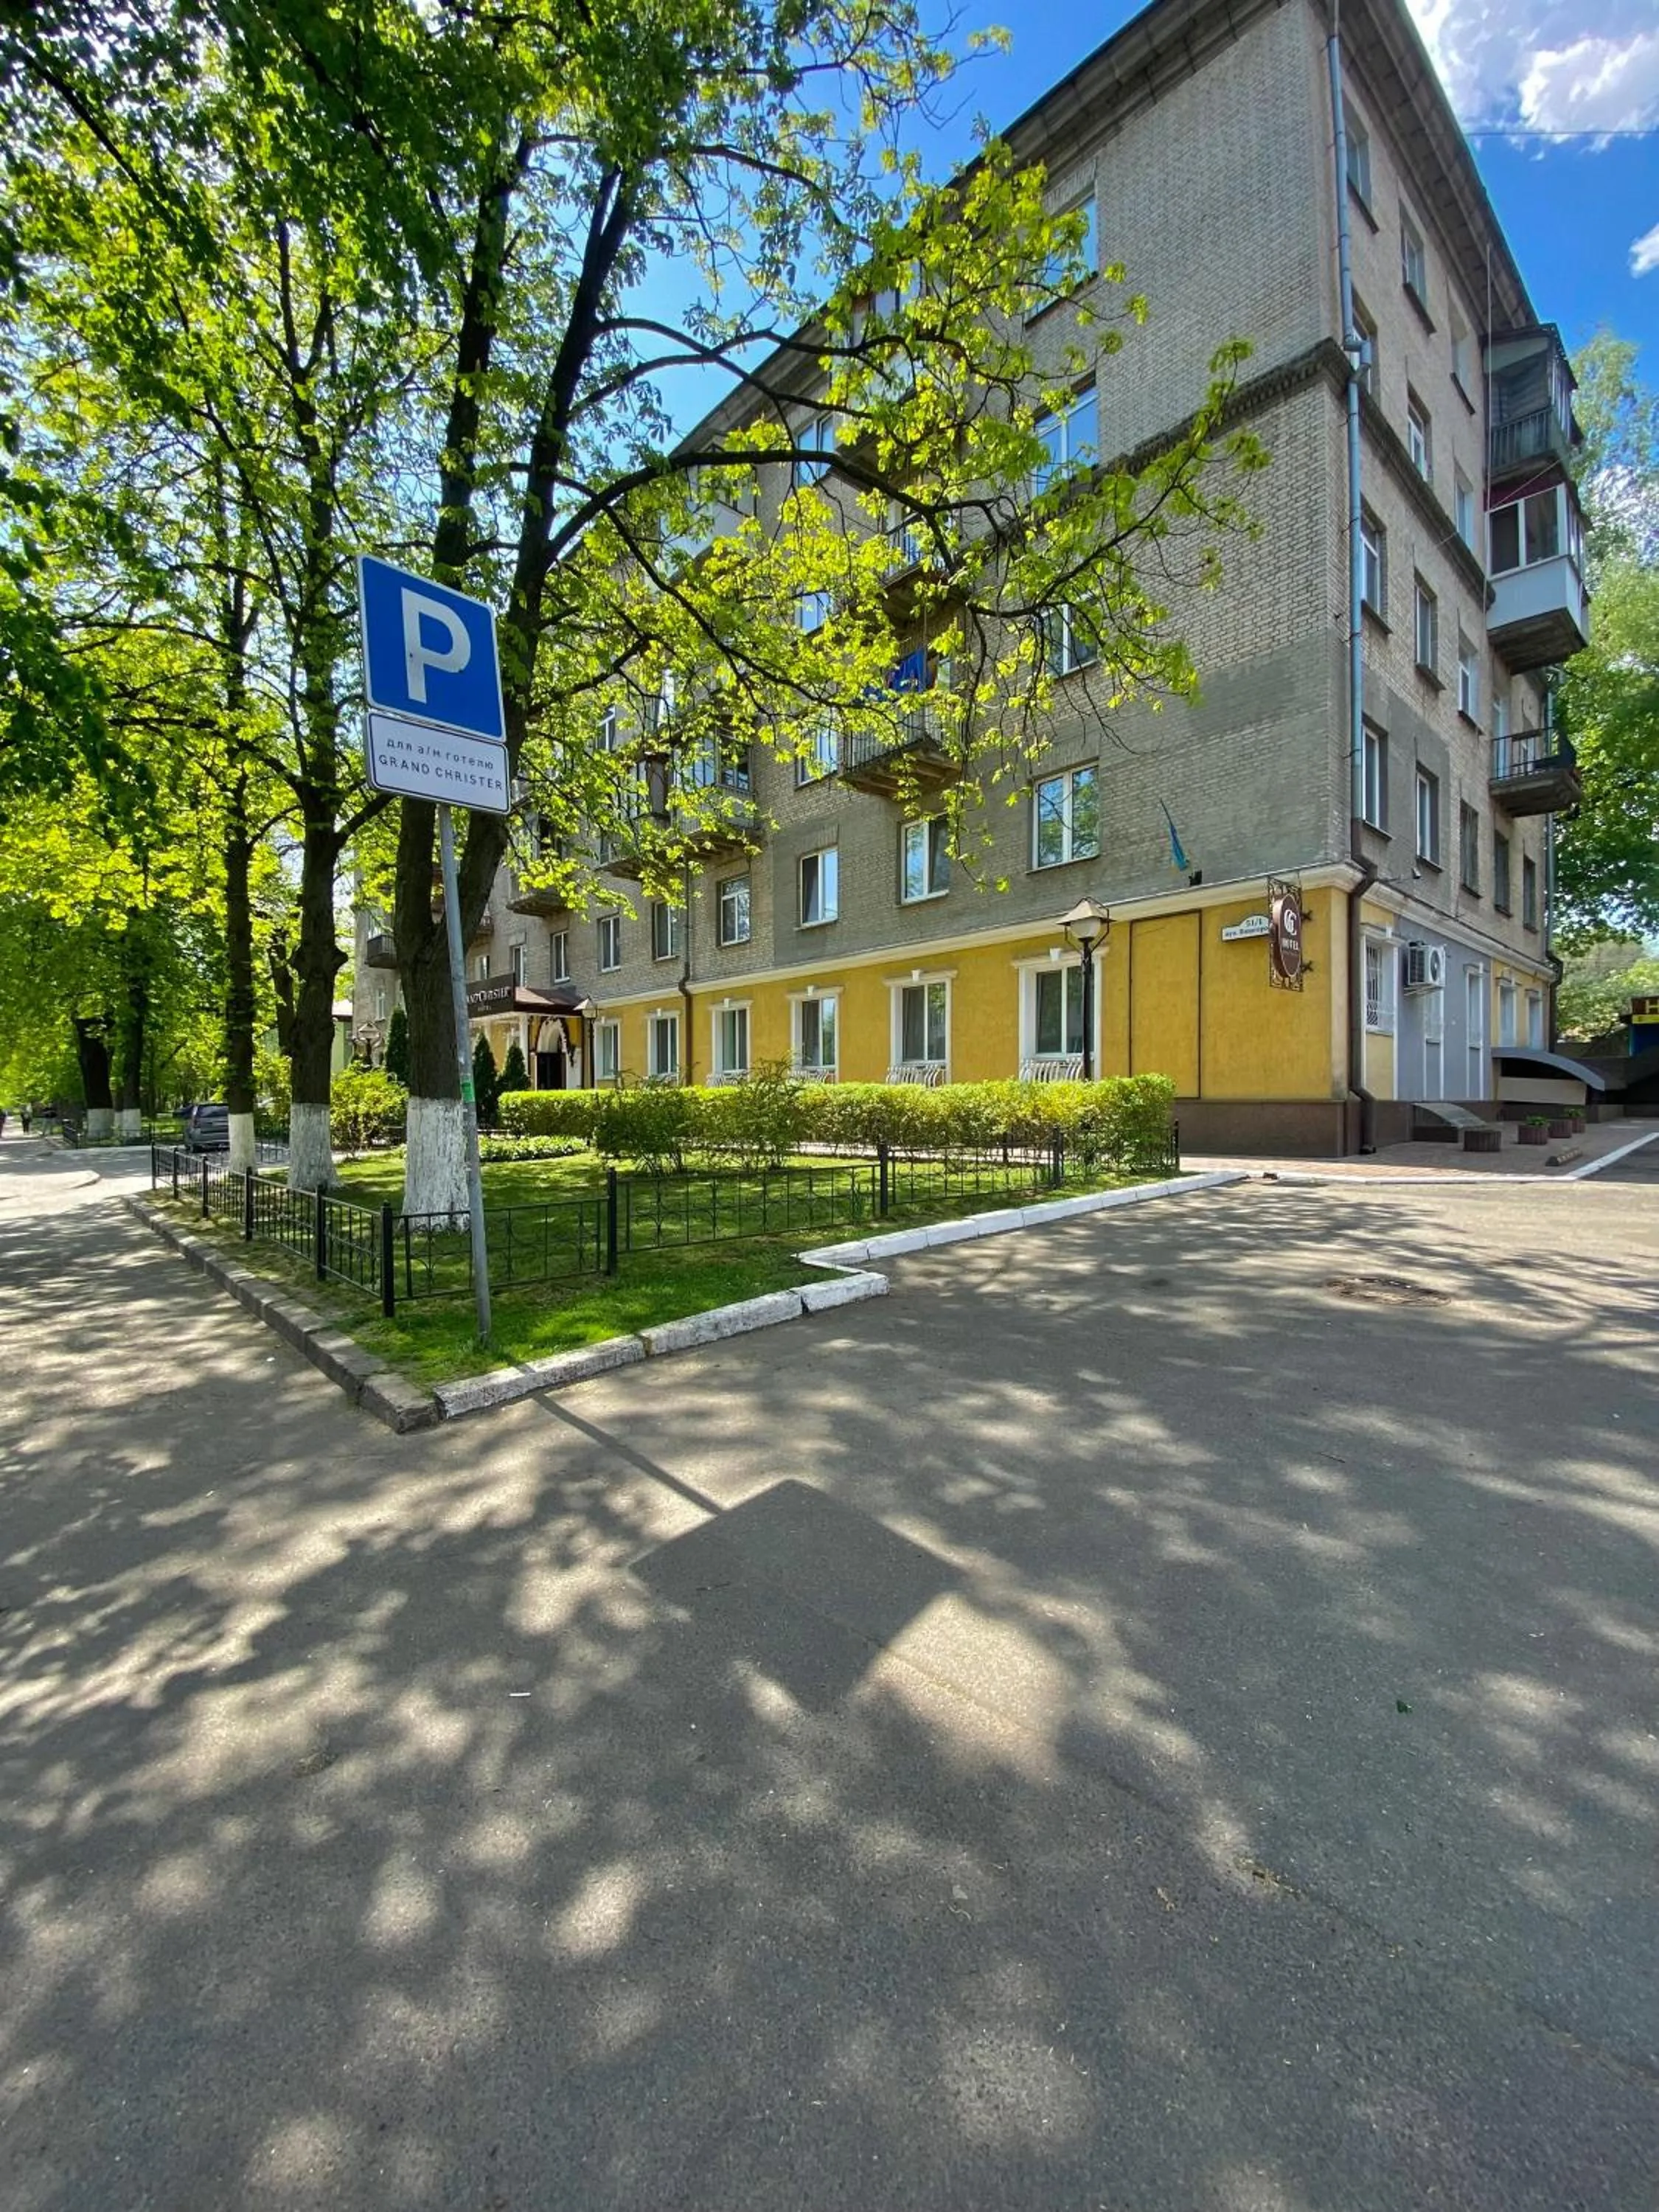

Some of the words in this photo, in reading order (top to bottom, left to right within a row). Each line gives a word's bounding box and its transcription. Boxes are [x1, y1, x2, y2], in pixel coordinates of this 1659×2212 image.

[400, 587, 471, 704] P
[378, 754, 430, 775] GRAND
[435, 767, 503, 790] CHRISTER
[387, 739, 412, 751] для
[445, 752, 493, 770] готелю
